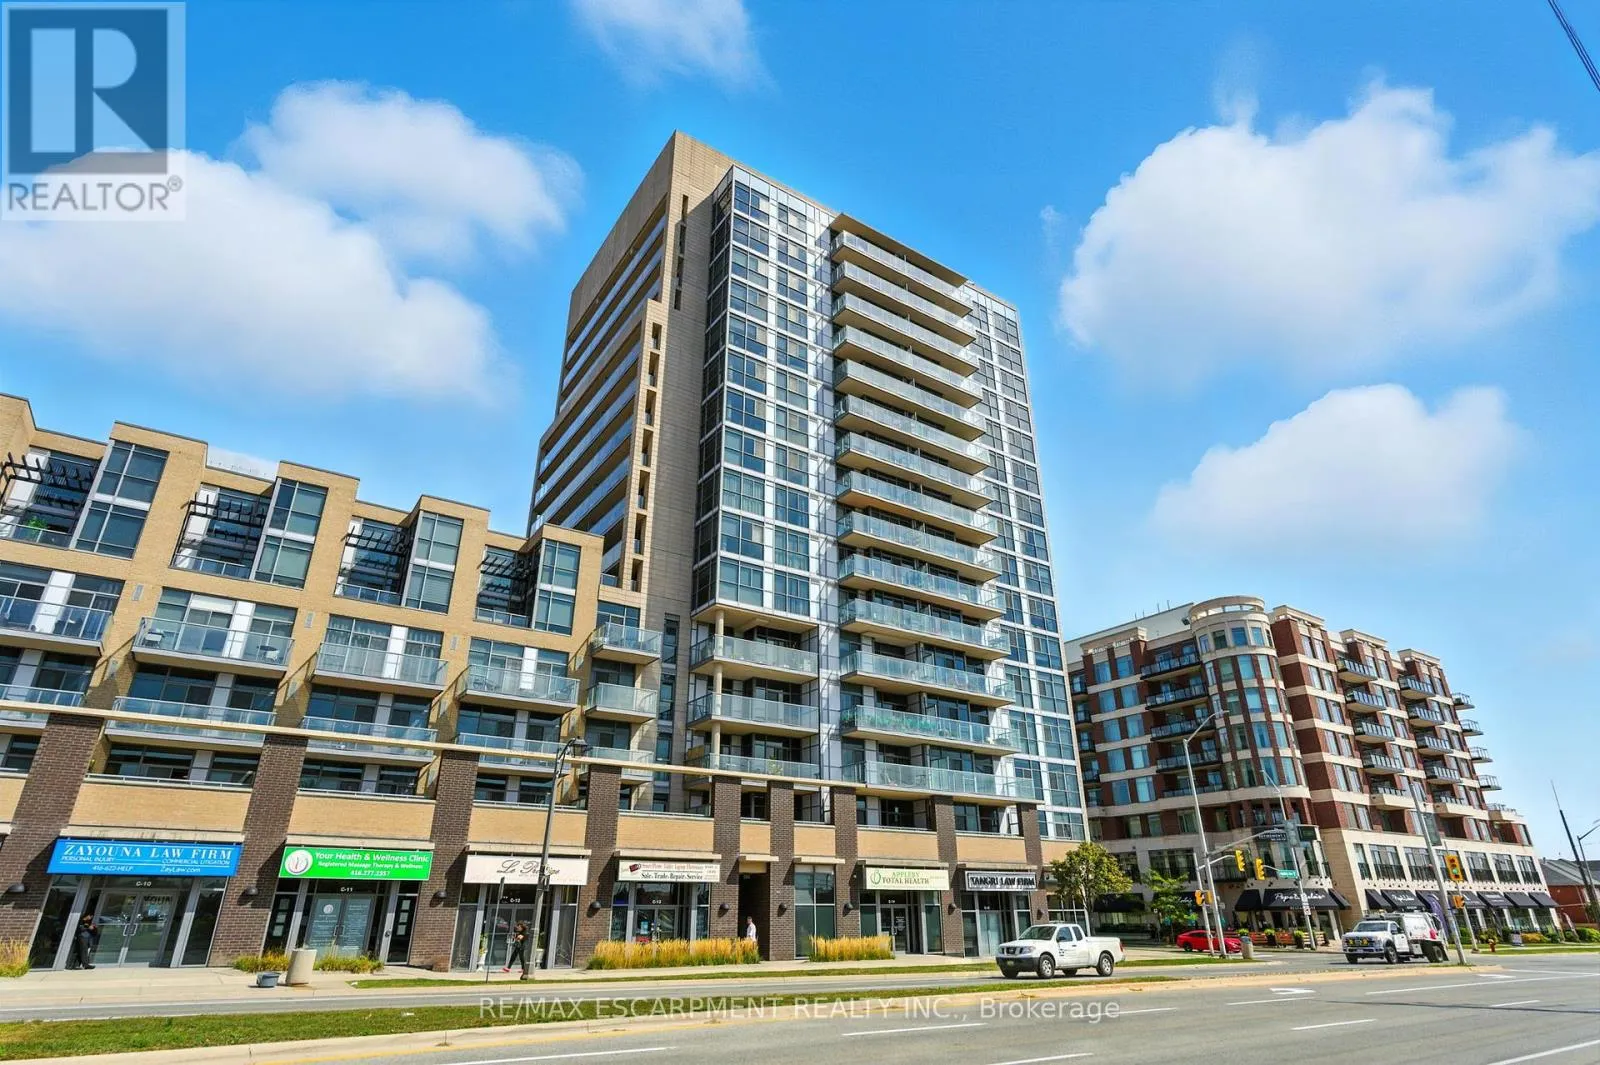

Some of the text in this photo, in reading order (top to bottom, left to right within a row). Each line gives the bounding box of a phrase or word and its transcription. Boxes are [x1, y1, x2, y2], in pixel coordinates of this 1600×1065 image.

[63, 844, 232, 860] ZAYOUNA LAW FIRM
[315, 852, 429, 862] Your Health & Wellness Clinic
[496, 859, 520, 874] Le
[904, 877, 930, 885] HEALTH
[1000, 877, 1016, 886] LAW
